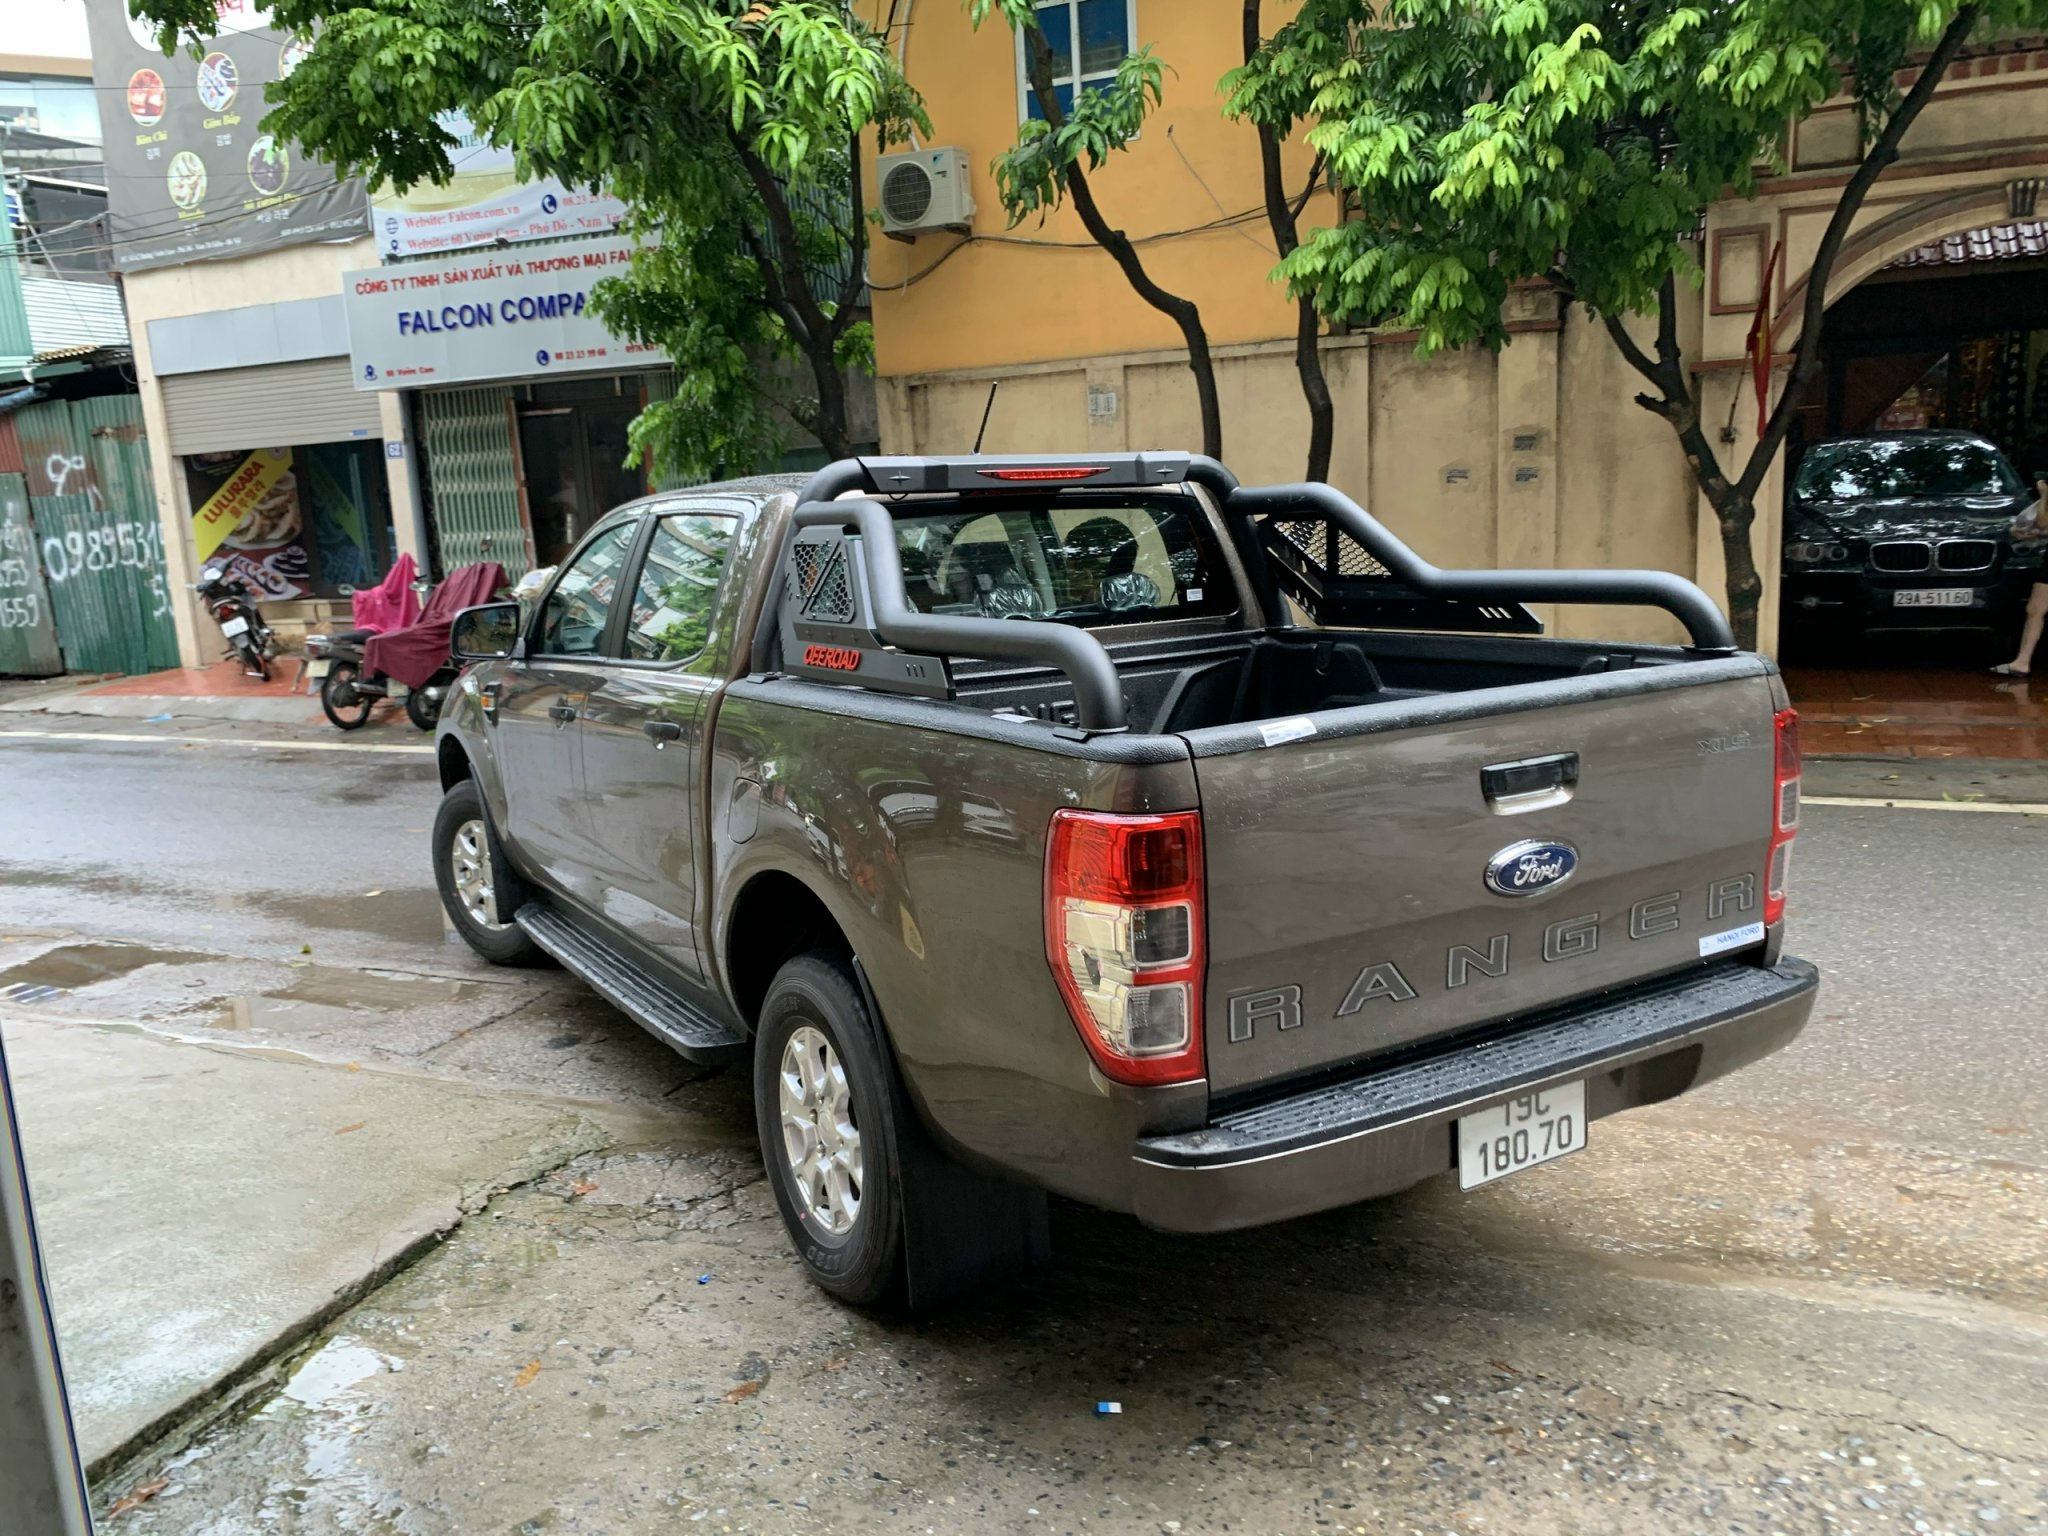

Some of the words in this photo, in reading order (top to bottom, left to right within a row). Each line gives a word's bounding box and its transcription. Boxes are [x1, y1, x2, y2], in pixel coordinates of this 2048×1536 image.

[404, 215, 446, 228] Website:
[355, 278, 388, 295] CÔNG
[391, 278, 407, 291] TY
[409, 274, 441, 289] TNHH
[506, 259, 524, 276] VÀ
[584, 252, 607, 269] MẠI
[397, 302, 494, 336] FALCON
[501, 292, 588, 323] COMPA
[203, 460, 265, 524] LULURARA
[803, 644, 861, 671] OFFROAD
[1513, 851, 1563, 887] Ford
[1227, 871, 1756, 1044] RANGER
[1478, 1114, 1573, 1177] 180.70
